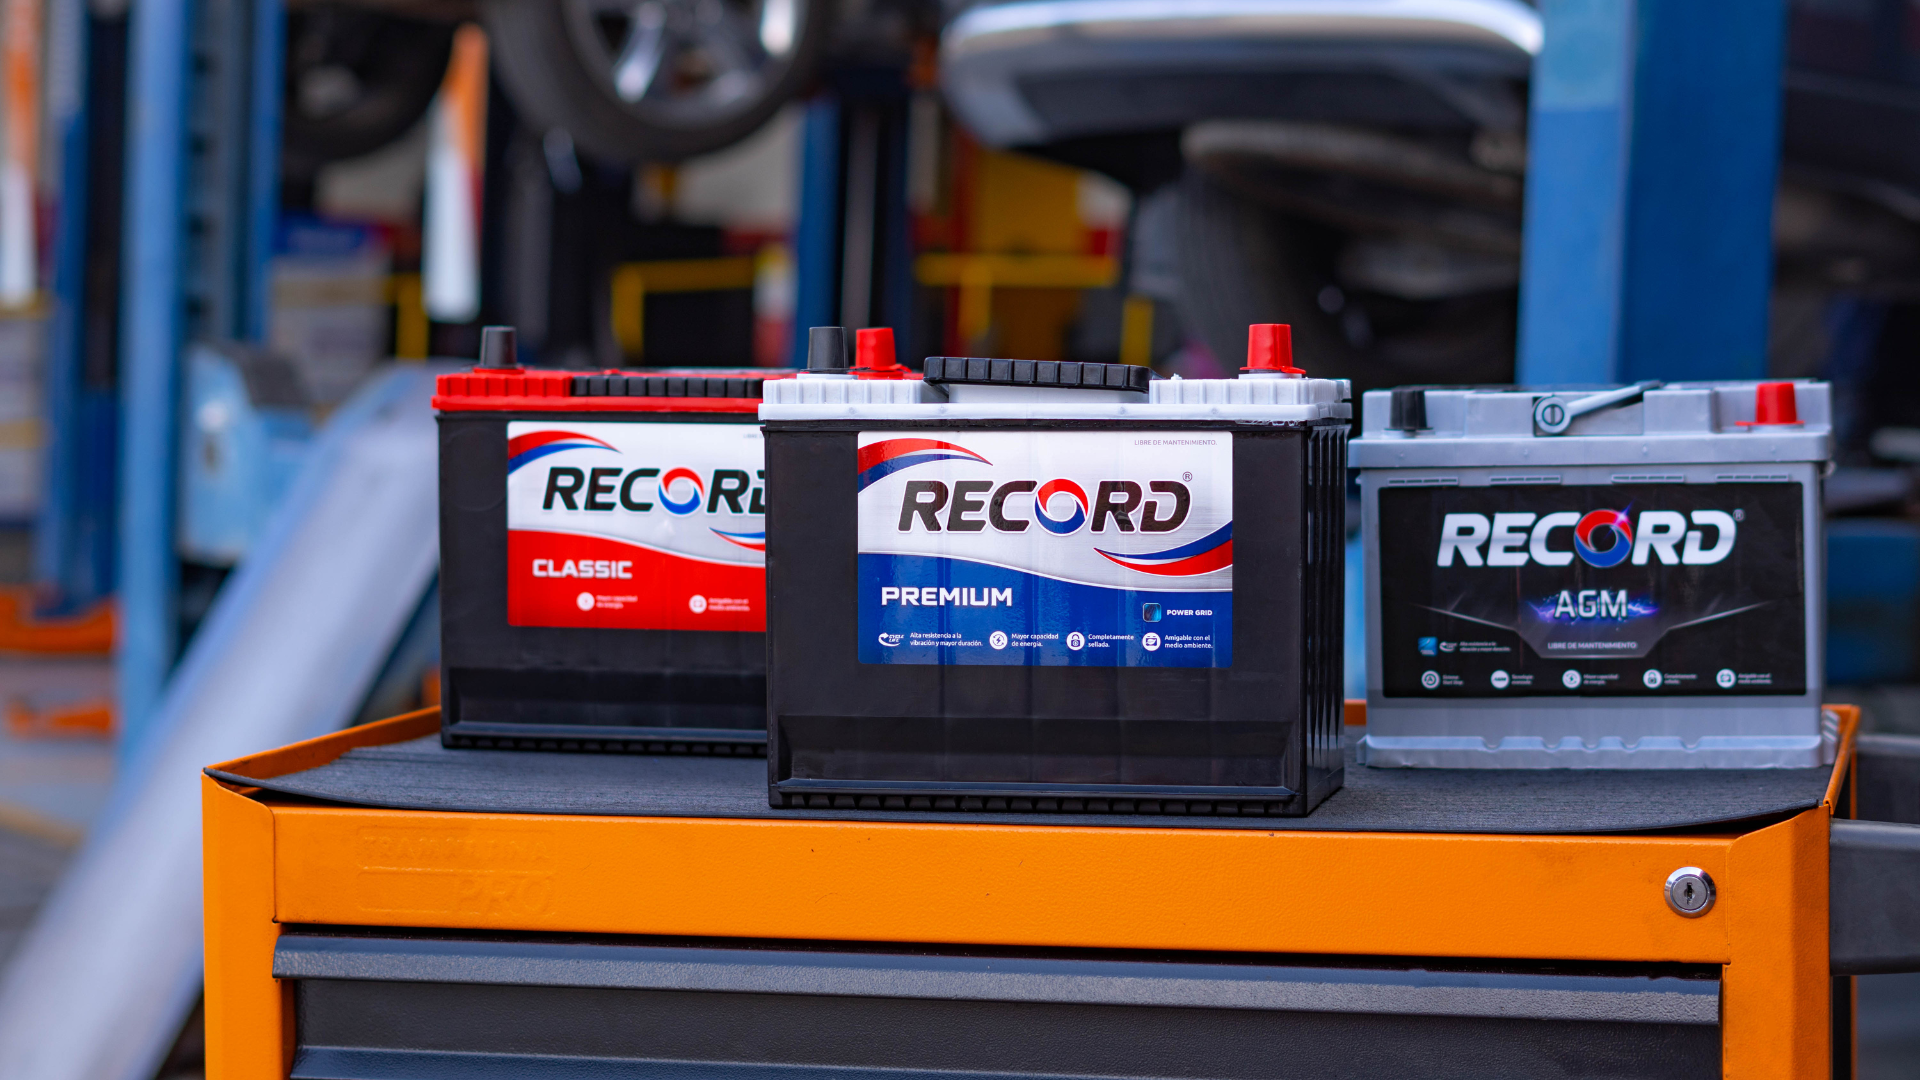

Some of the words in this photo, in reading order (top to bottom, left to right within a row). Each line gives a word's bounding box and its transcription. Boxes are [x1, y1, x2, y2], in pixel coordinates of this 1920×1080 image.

[532, 558, 633, 580] CLASSIC
[881, 586, 1013, 607] PREMIUM
[1554, 589, 1628, 618] AGM
[1088, 633, 1135, 641] Completamente
[1164, 634, 1192, 642] Amigable
[1578, 642, 1638, 650] MANTENIMIENTO
[455, 874, 553, 917] PRO
